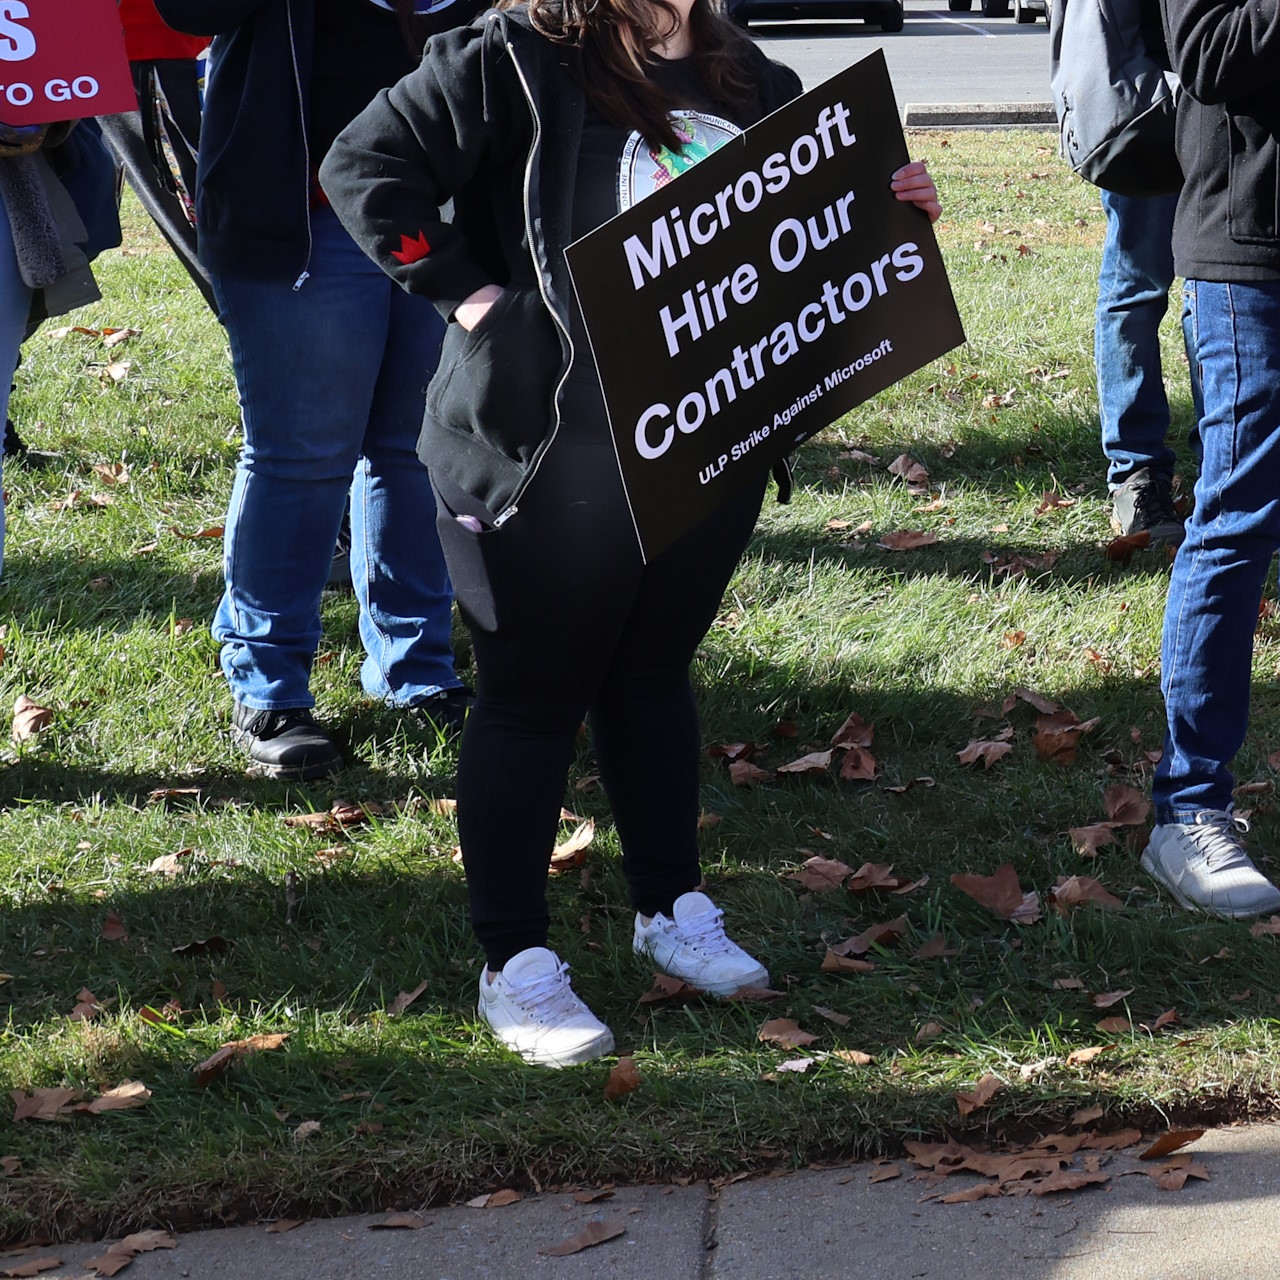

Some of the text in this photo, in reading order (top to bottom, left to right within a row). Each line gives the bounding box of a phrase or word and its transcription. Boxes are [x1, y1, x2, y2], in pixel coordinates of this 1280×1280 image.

[44, 75, 98, 102] GO
[624, 138, 636, 166] STUDIOS
[622, 101, 857, 290] Microsoft
[633, 241, 925, 460] Contractors
[658, 190, 855, 359] Hire Our
[698, 339, 893, 485] ULP Strike Against Microsoft
